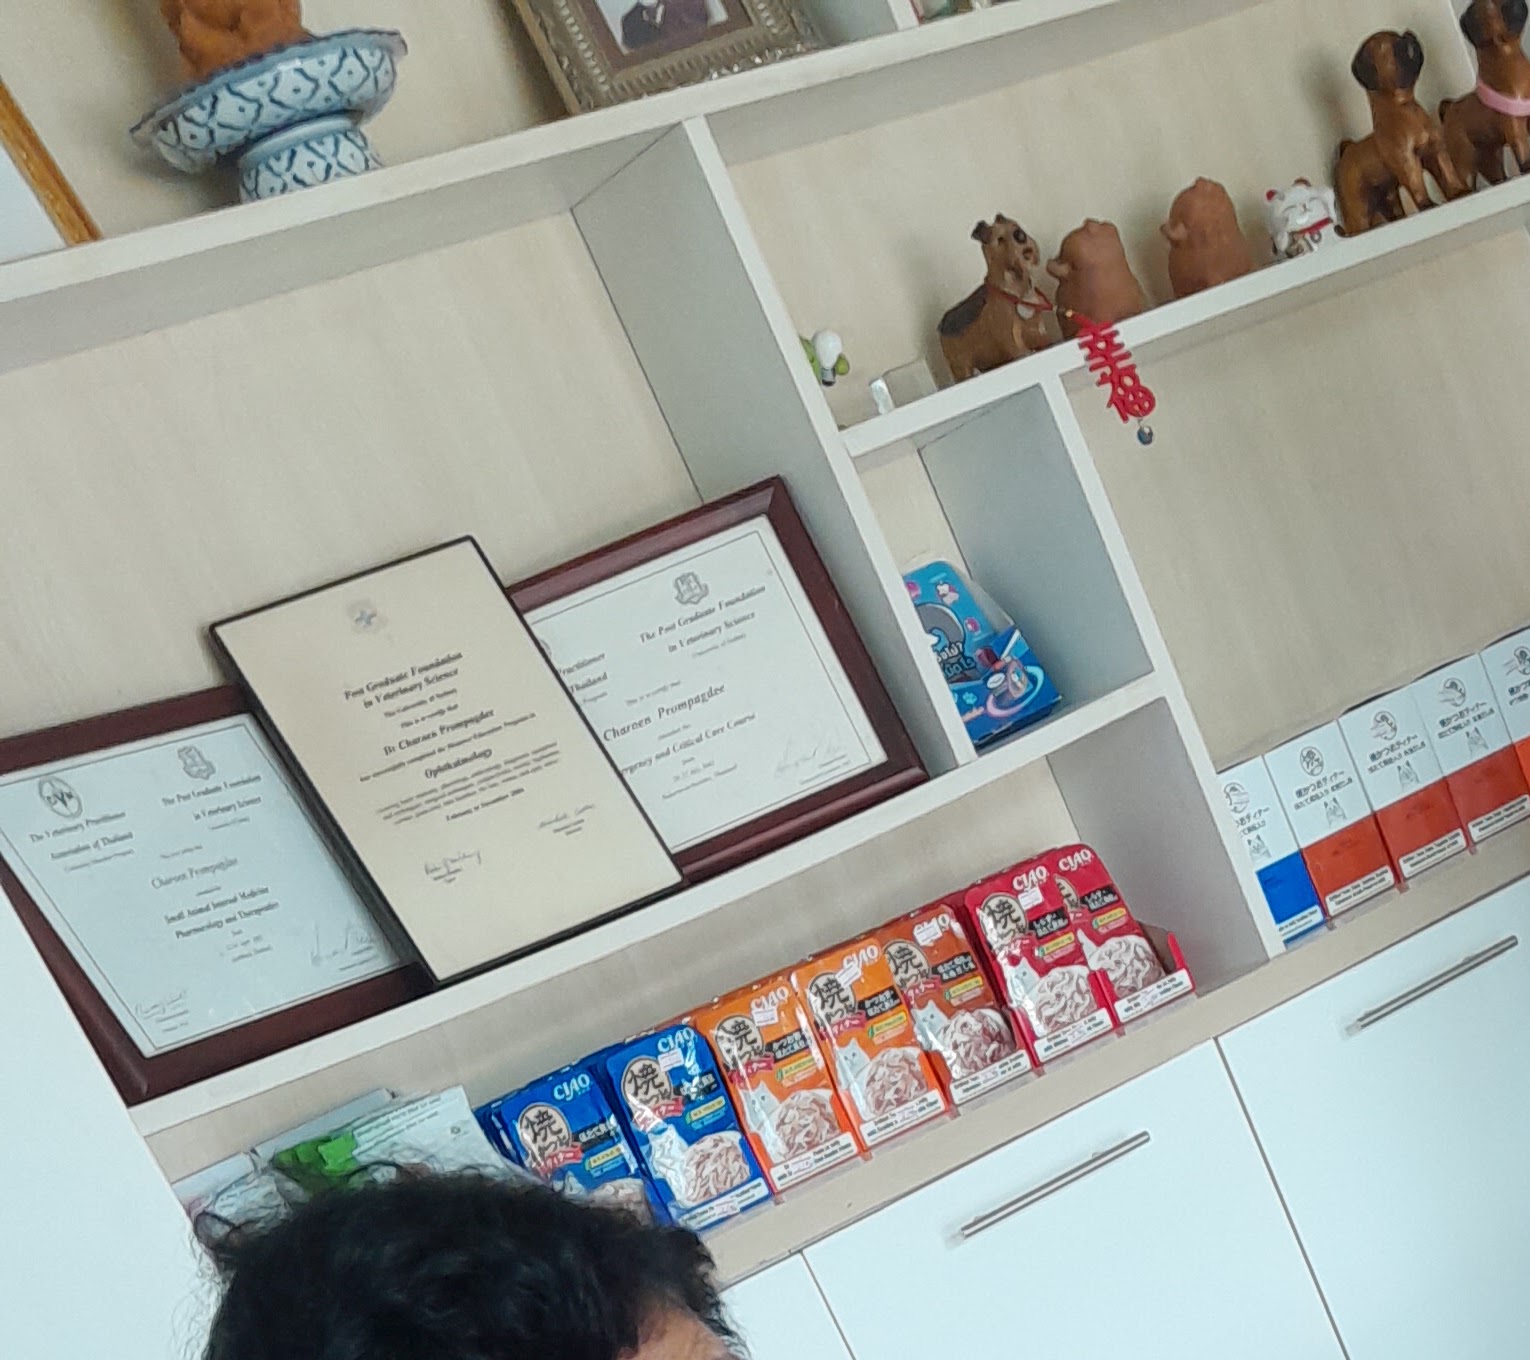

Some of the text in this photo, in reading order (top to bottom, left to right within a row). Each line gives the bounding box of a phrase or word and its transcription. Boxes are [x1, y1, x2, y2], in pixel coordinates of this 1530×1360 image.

[1059, 848, 1093, 872] CIAO
[1013, 865, 1048, 891] CIAO
[813, 977, 850, 1010] 焼
[657, 1027, 695, 1053] CIAO
[553, 1073, 591, 1102] CIAO
[627, 1063, 664, 1097] 焼
[524, 1109, 563, 1144] 焼
